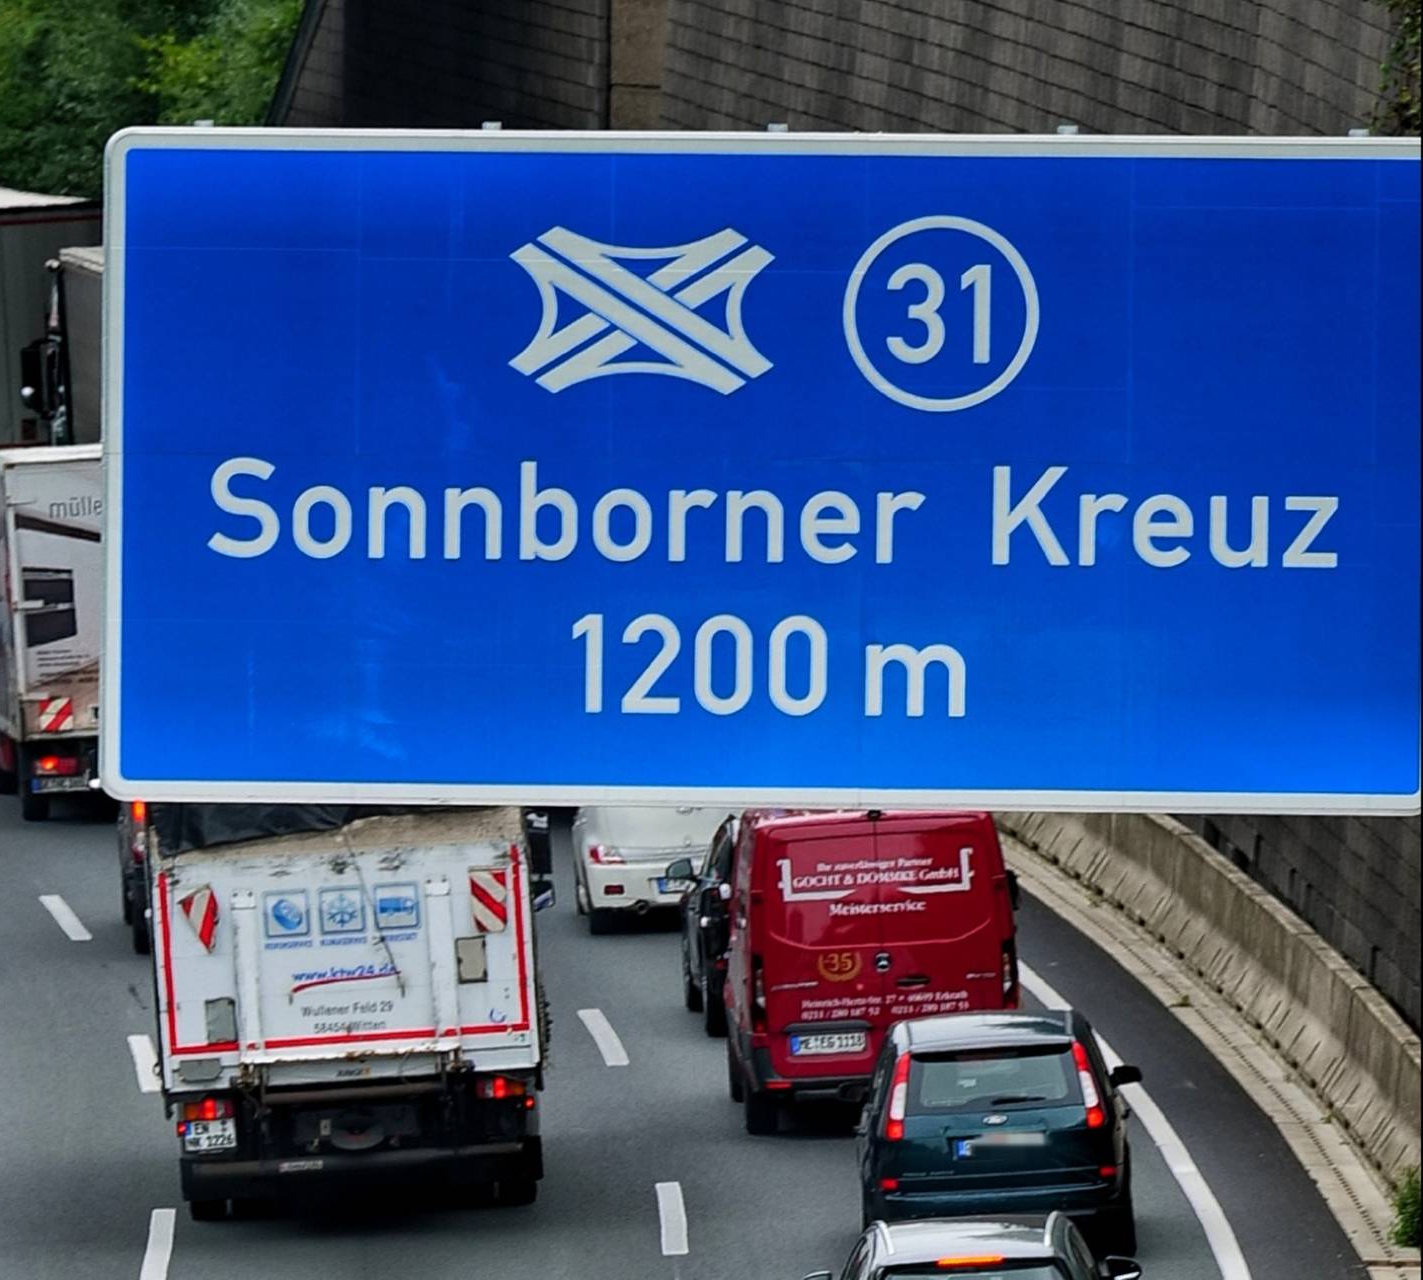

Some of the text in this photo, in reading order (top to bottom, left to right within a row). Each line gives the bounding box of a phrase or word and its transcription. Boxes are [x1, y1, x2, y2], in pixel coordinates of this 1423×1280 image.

[886, 263, 990, 364] 31
[49, 495, 103, 519] mülle
[208, 458, 1338, 568] Sonnborner Kreuz
[572, 614, 966, 717] 1200 m
[843, 873, 853, 885] &
[919, 868, 959, 881] GmbH
[829, 900, 926, 916] Meisterservice
[352, 1001, 377, 1014] Feld
